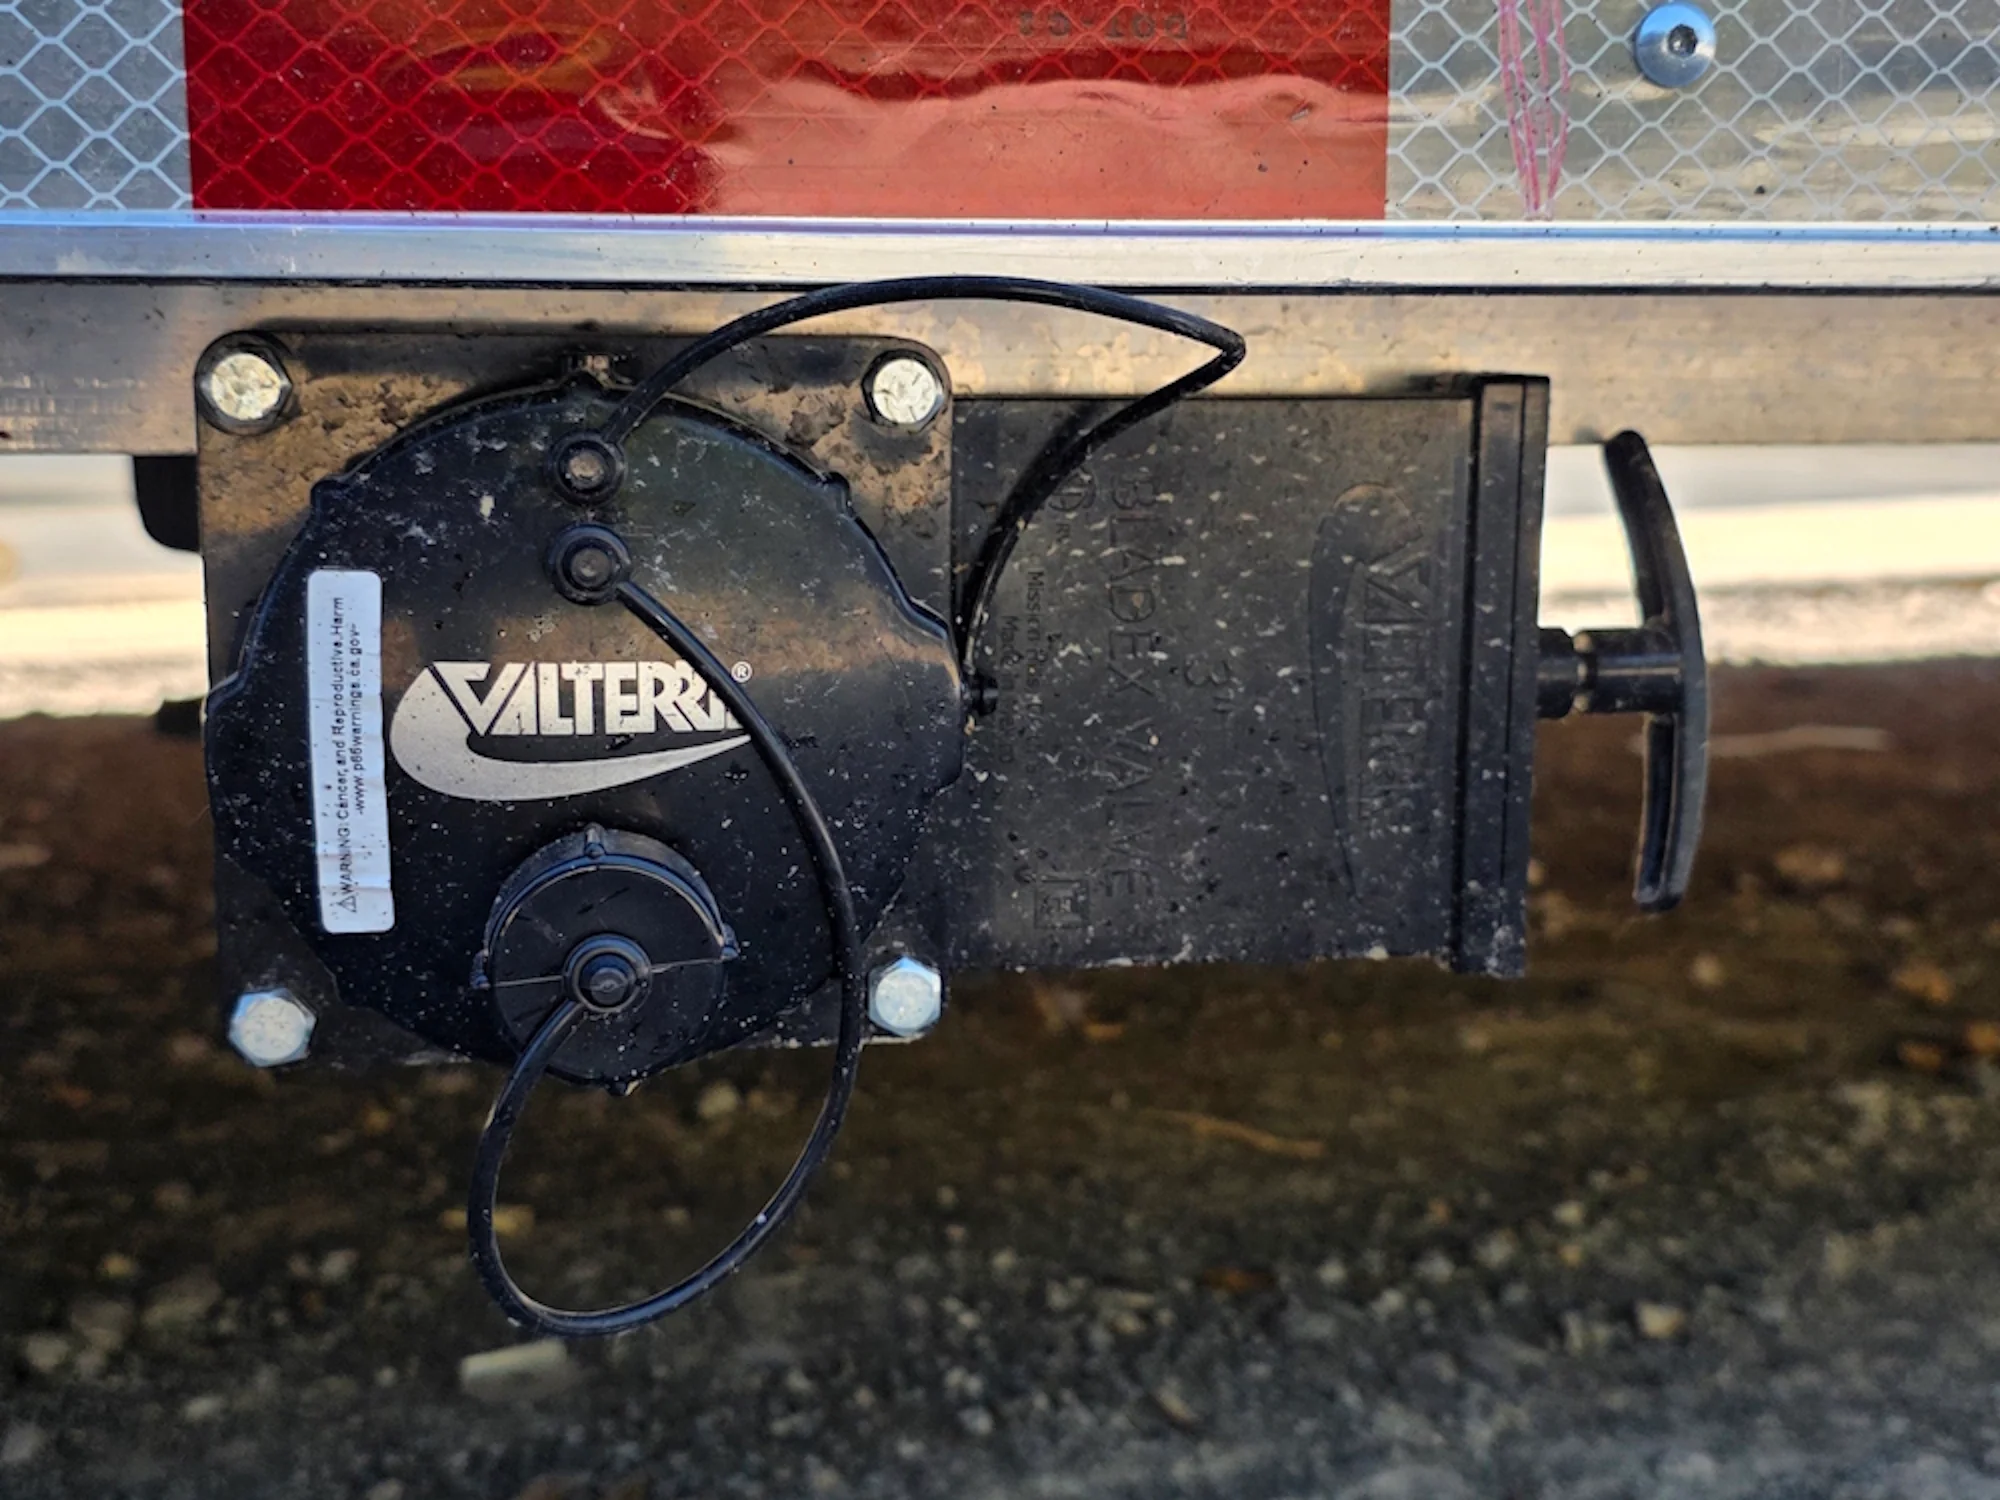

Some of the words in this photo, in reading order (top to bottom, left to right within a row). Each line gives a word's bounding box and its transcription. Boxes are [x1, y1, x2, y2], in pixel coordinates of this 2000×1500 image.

[330, 597, 345, 635] Harm
[1026, 571, 1045, 642] Mission
[1107, 475, 1160, 697] BLADEX
[331, 641, 347, 735] Reproductive
[333, 739, 347, 765] and
[1106, 716, 1154, 897] VALVE
